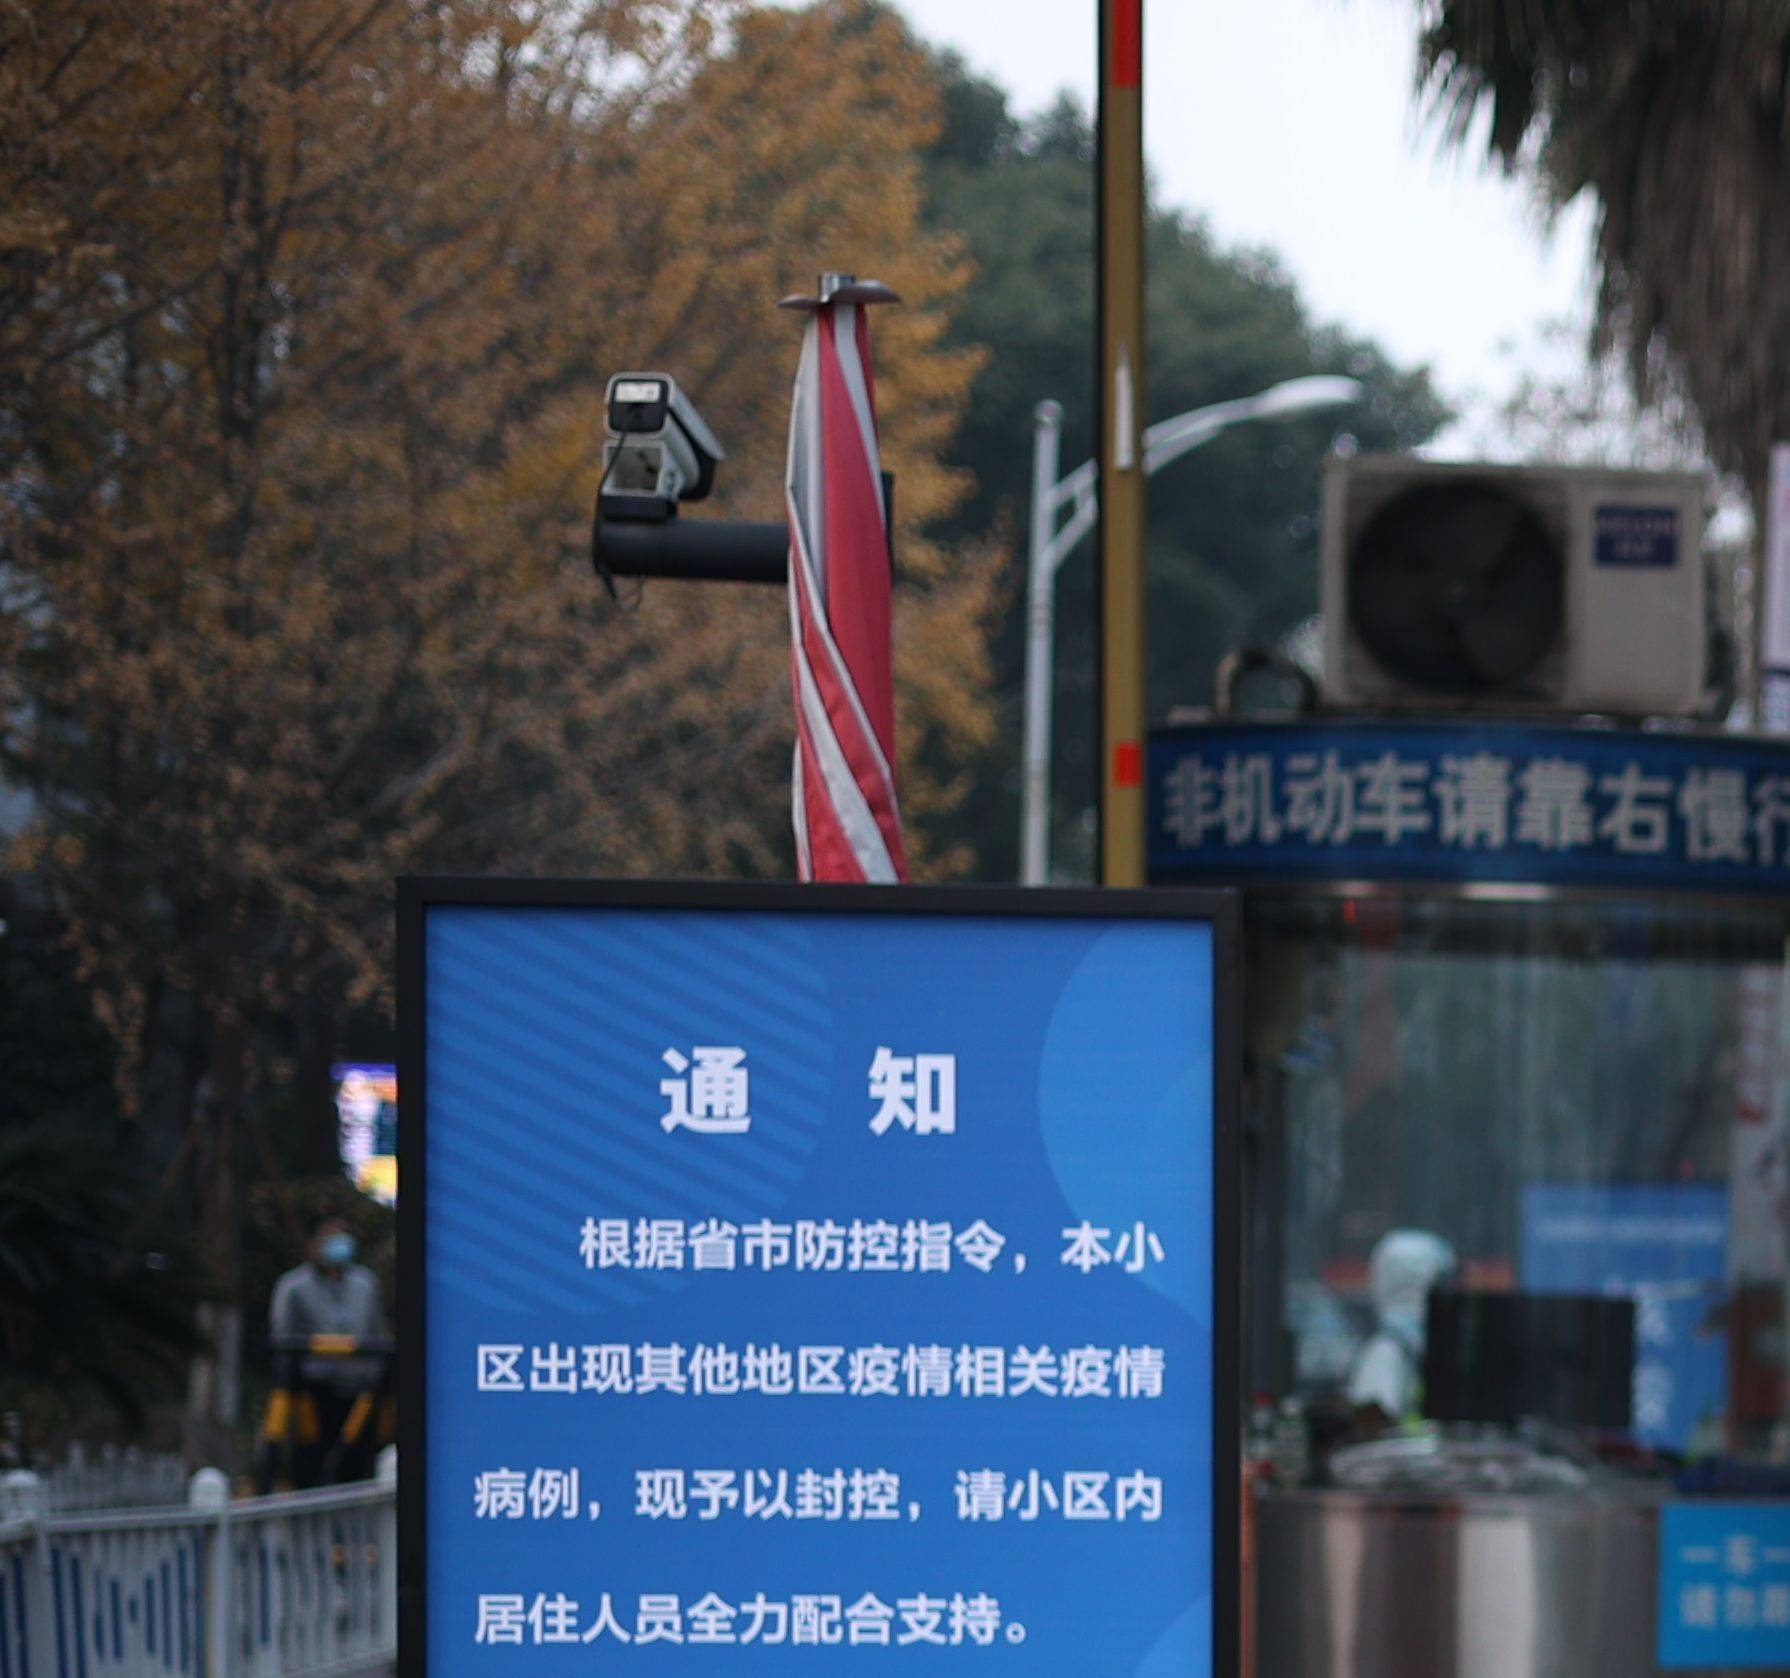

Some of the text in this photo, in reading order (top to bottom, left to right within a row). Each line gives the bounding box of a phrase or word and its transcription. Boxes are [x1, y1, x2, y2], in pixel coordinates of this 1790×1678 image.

[660, 1046, 957, 1135] 通知
[579, 1217, 1165, 1273] 根据省市防控指令，本小
[476, 1342, 1166, 1398] 区出现其他地区疫情相关疫情
[474, 1467, 1164, 1522] 病例，现予以封控，请小区内
[475, 1592, 1027, 1647] 居住人员全力配合支持。
